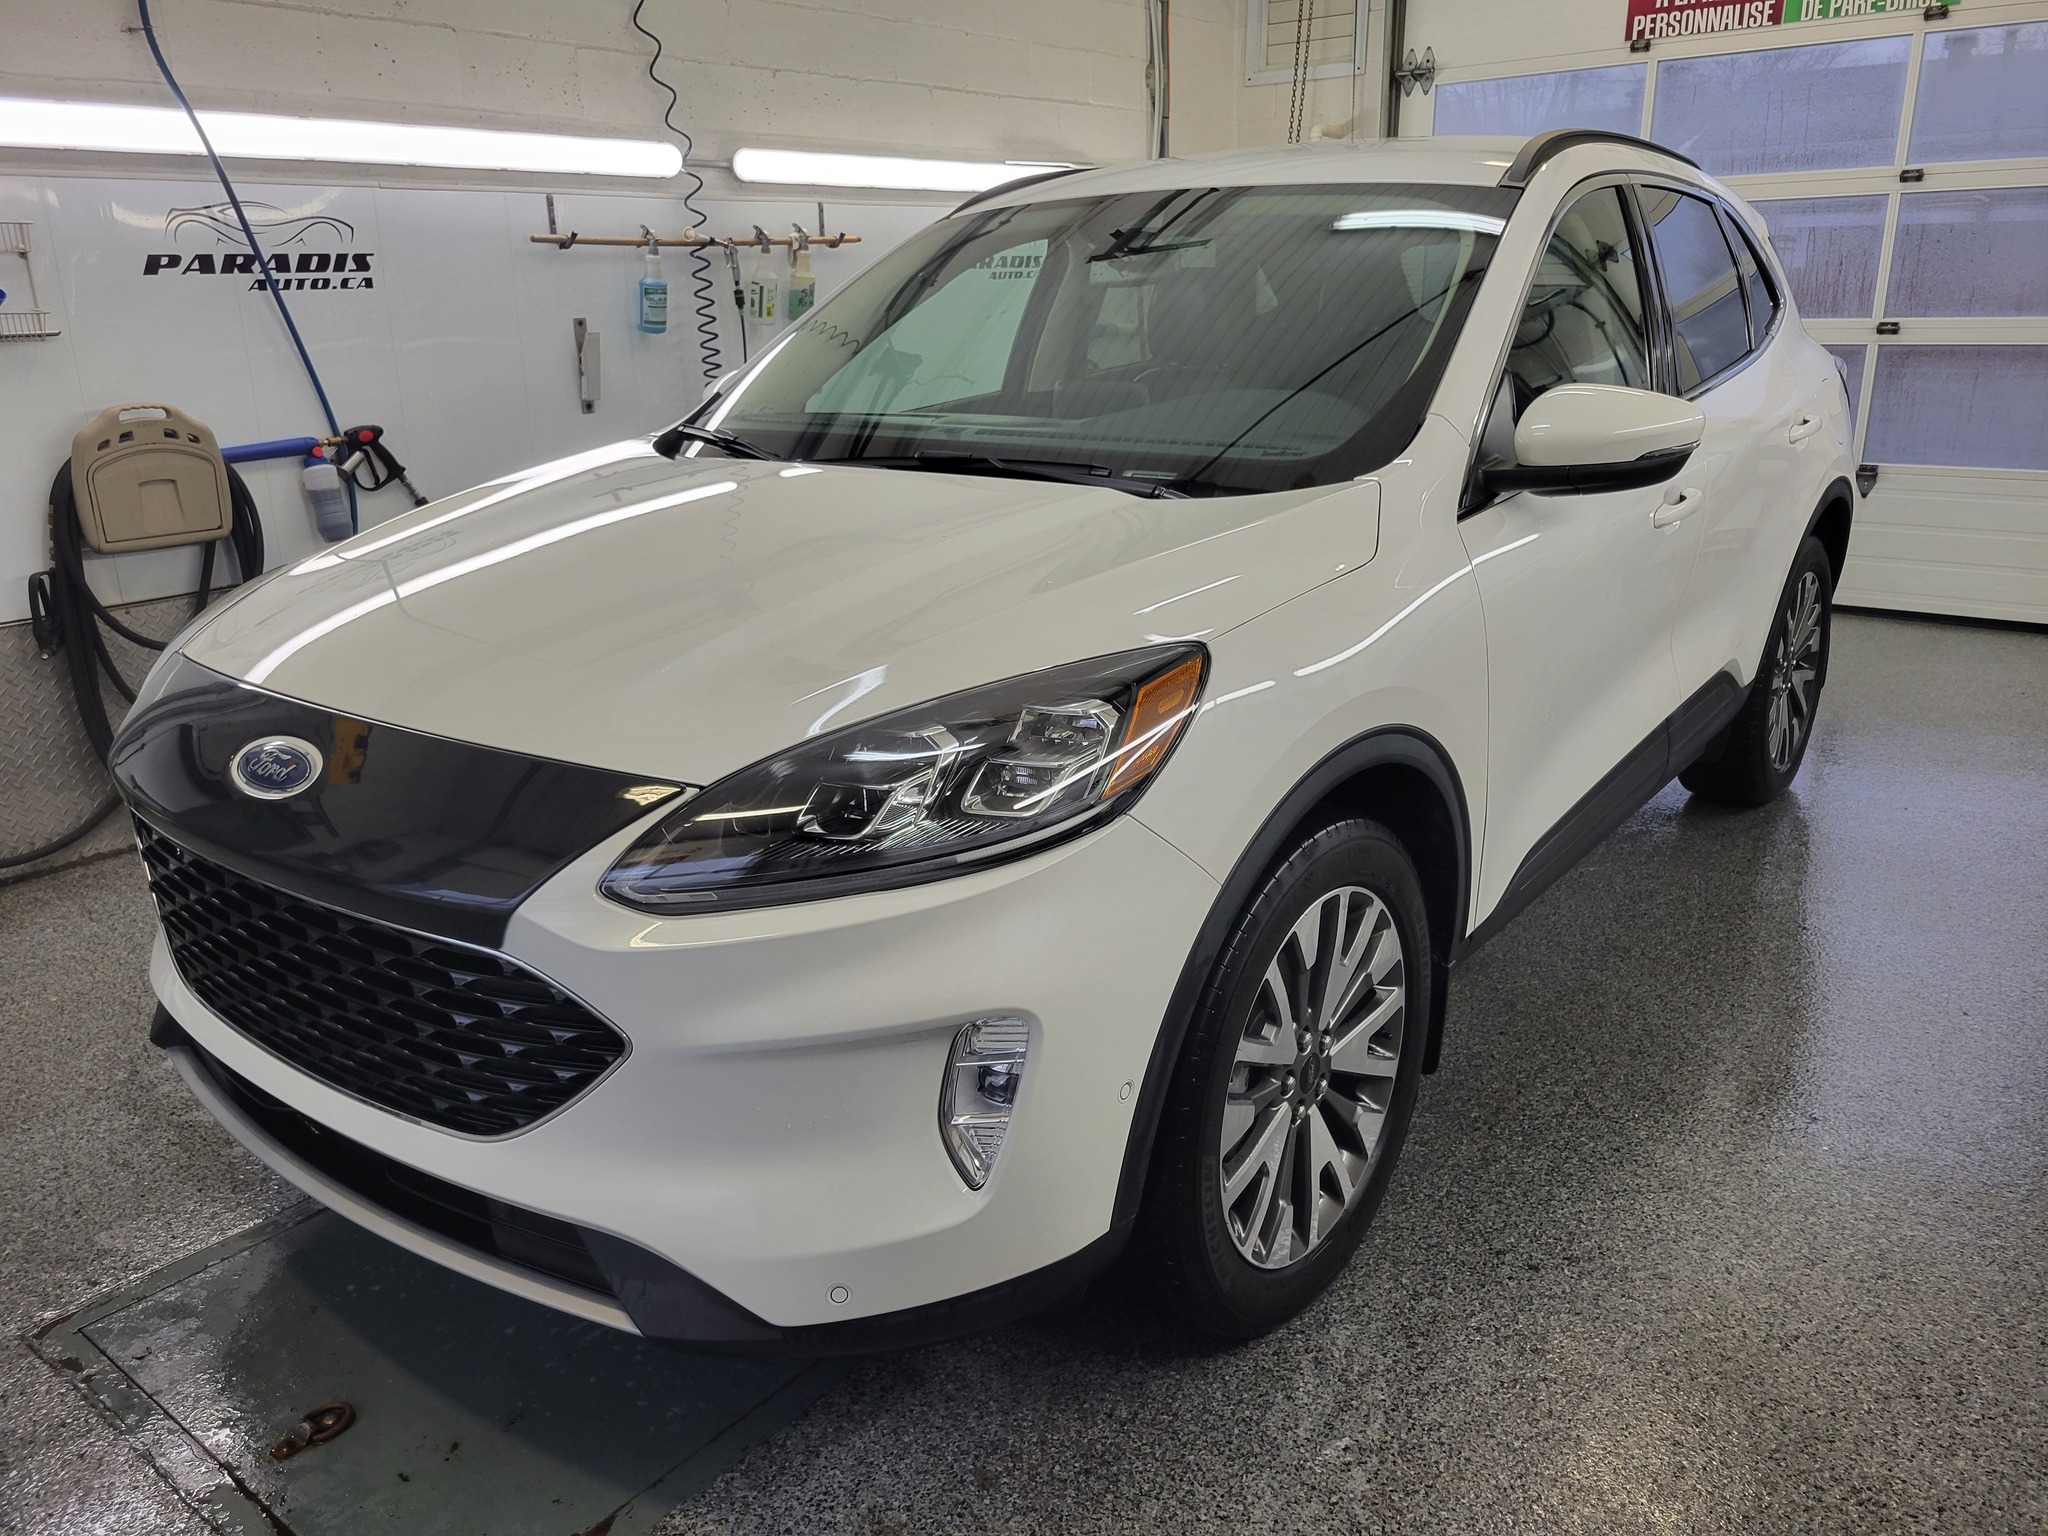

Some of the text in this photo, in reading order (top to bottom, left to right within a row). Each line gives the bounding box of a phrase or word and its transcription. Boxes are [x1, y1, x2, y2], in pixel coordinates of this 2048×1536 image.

[1632, 0, 1774, 40] PERSONNALISE
[1801, 0, 1943, 21] DE PARE-
[143, 253, 374, 275] PARADIS
[248, 277, 374, 291] AUTO.CA
[988, 270, 1039, 280] AUTO.C
[247, 748, 297, 782] Ford
